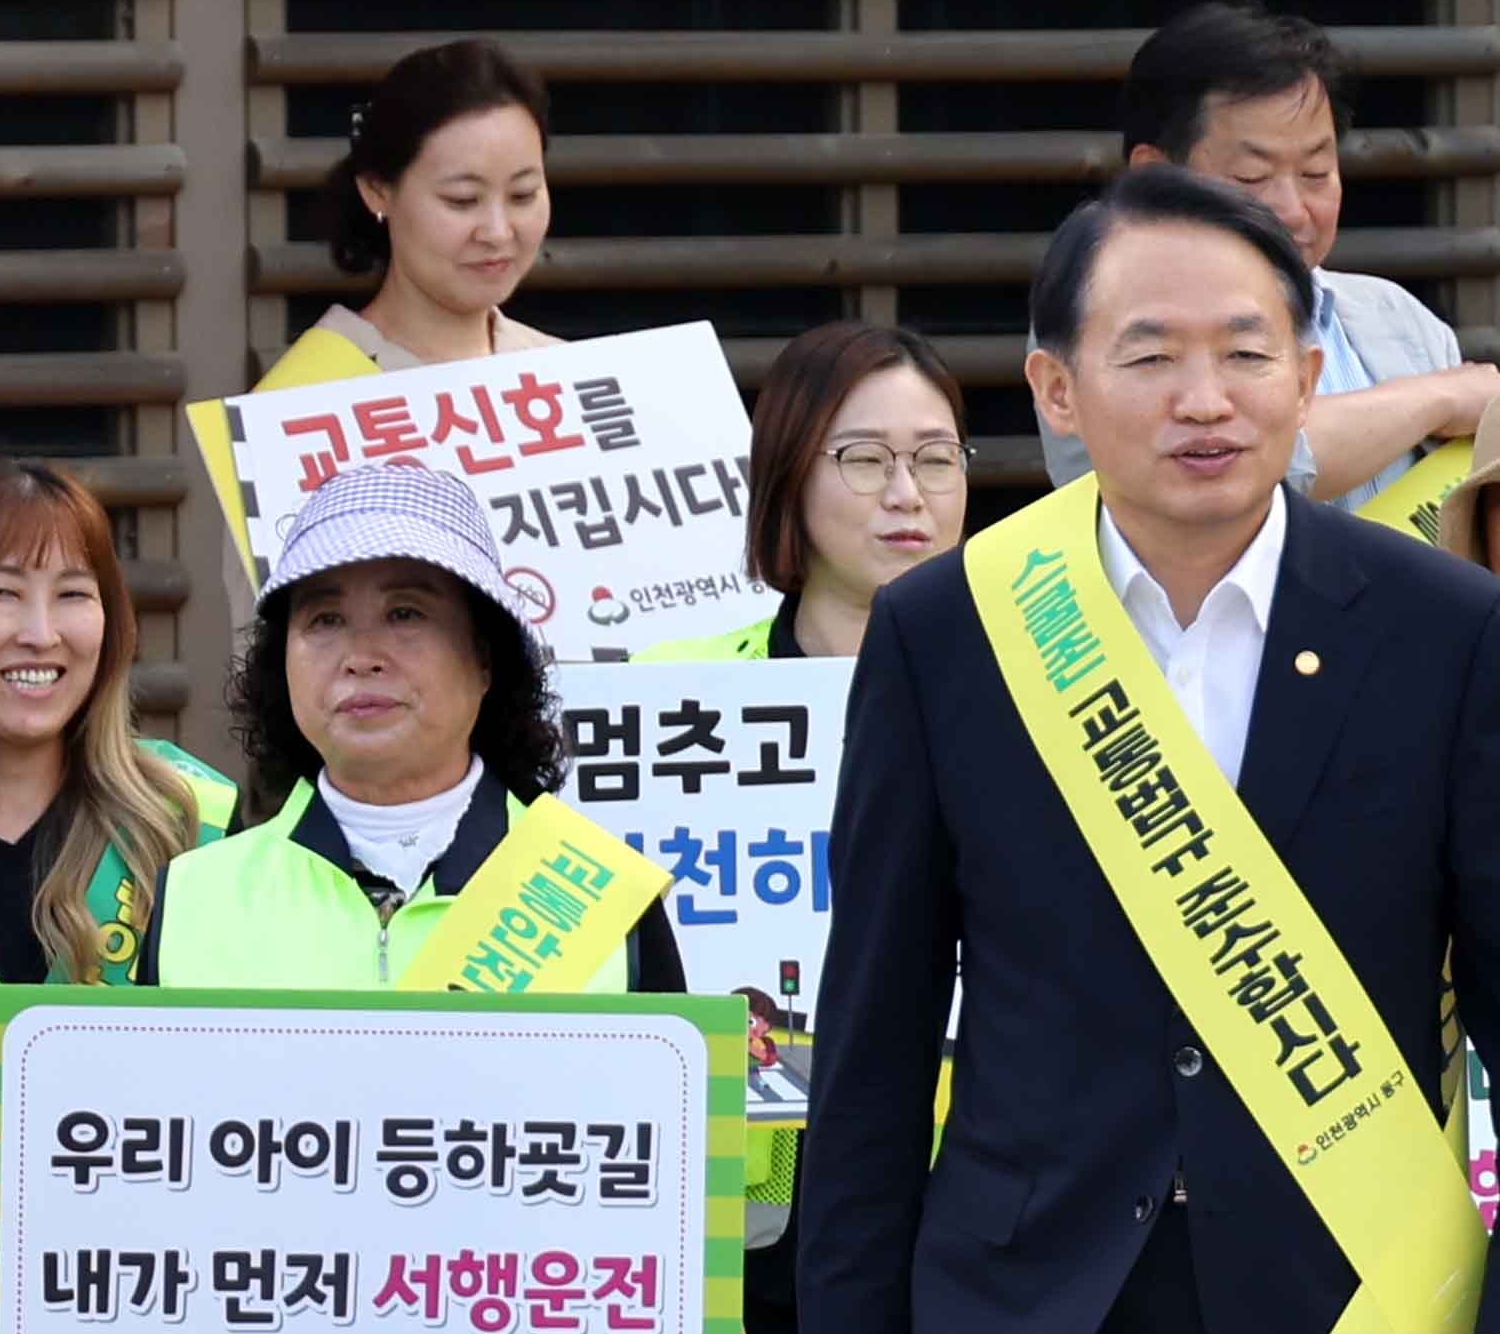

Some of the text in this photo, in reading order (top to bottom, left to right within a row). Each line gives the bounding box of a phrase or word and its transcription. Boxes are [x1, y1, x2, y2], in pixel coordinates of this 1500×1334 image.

[282, 372, 642, 492] 교통신호를
[630, 572, 741, 613] 인천광역시
[562, 699, 817, 803] 멈추고
[1011, 548, 1363, 1108] 스쿨존 교통법규 준수합시다
[51, 1110, 653, 1199] 우리 아이 등하굣길
[1314, 1069, 1408, 1154] 인천광역시 동구
[42, 1248, 657, 1333] 내가 먼저 서행운전
